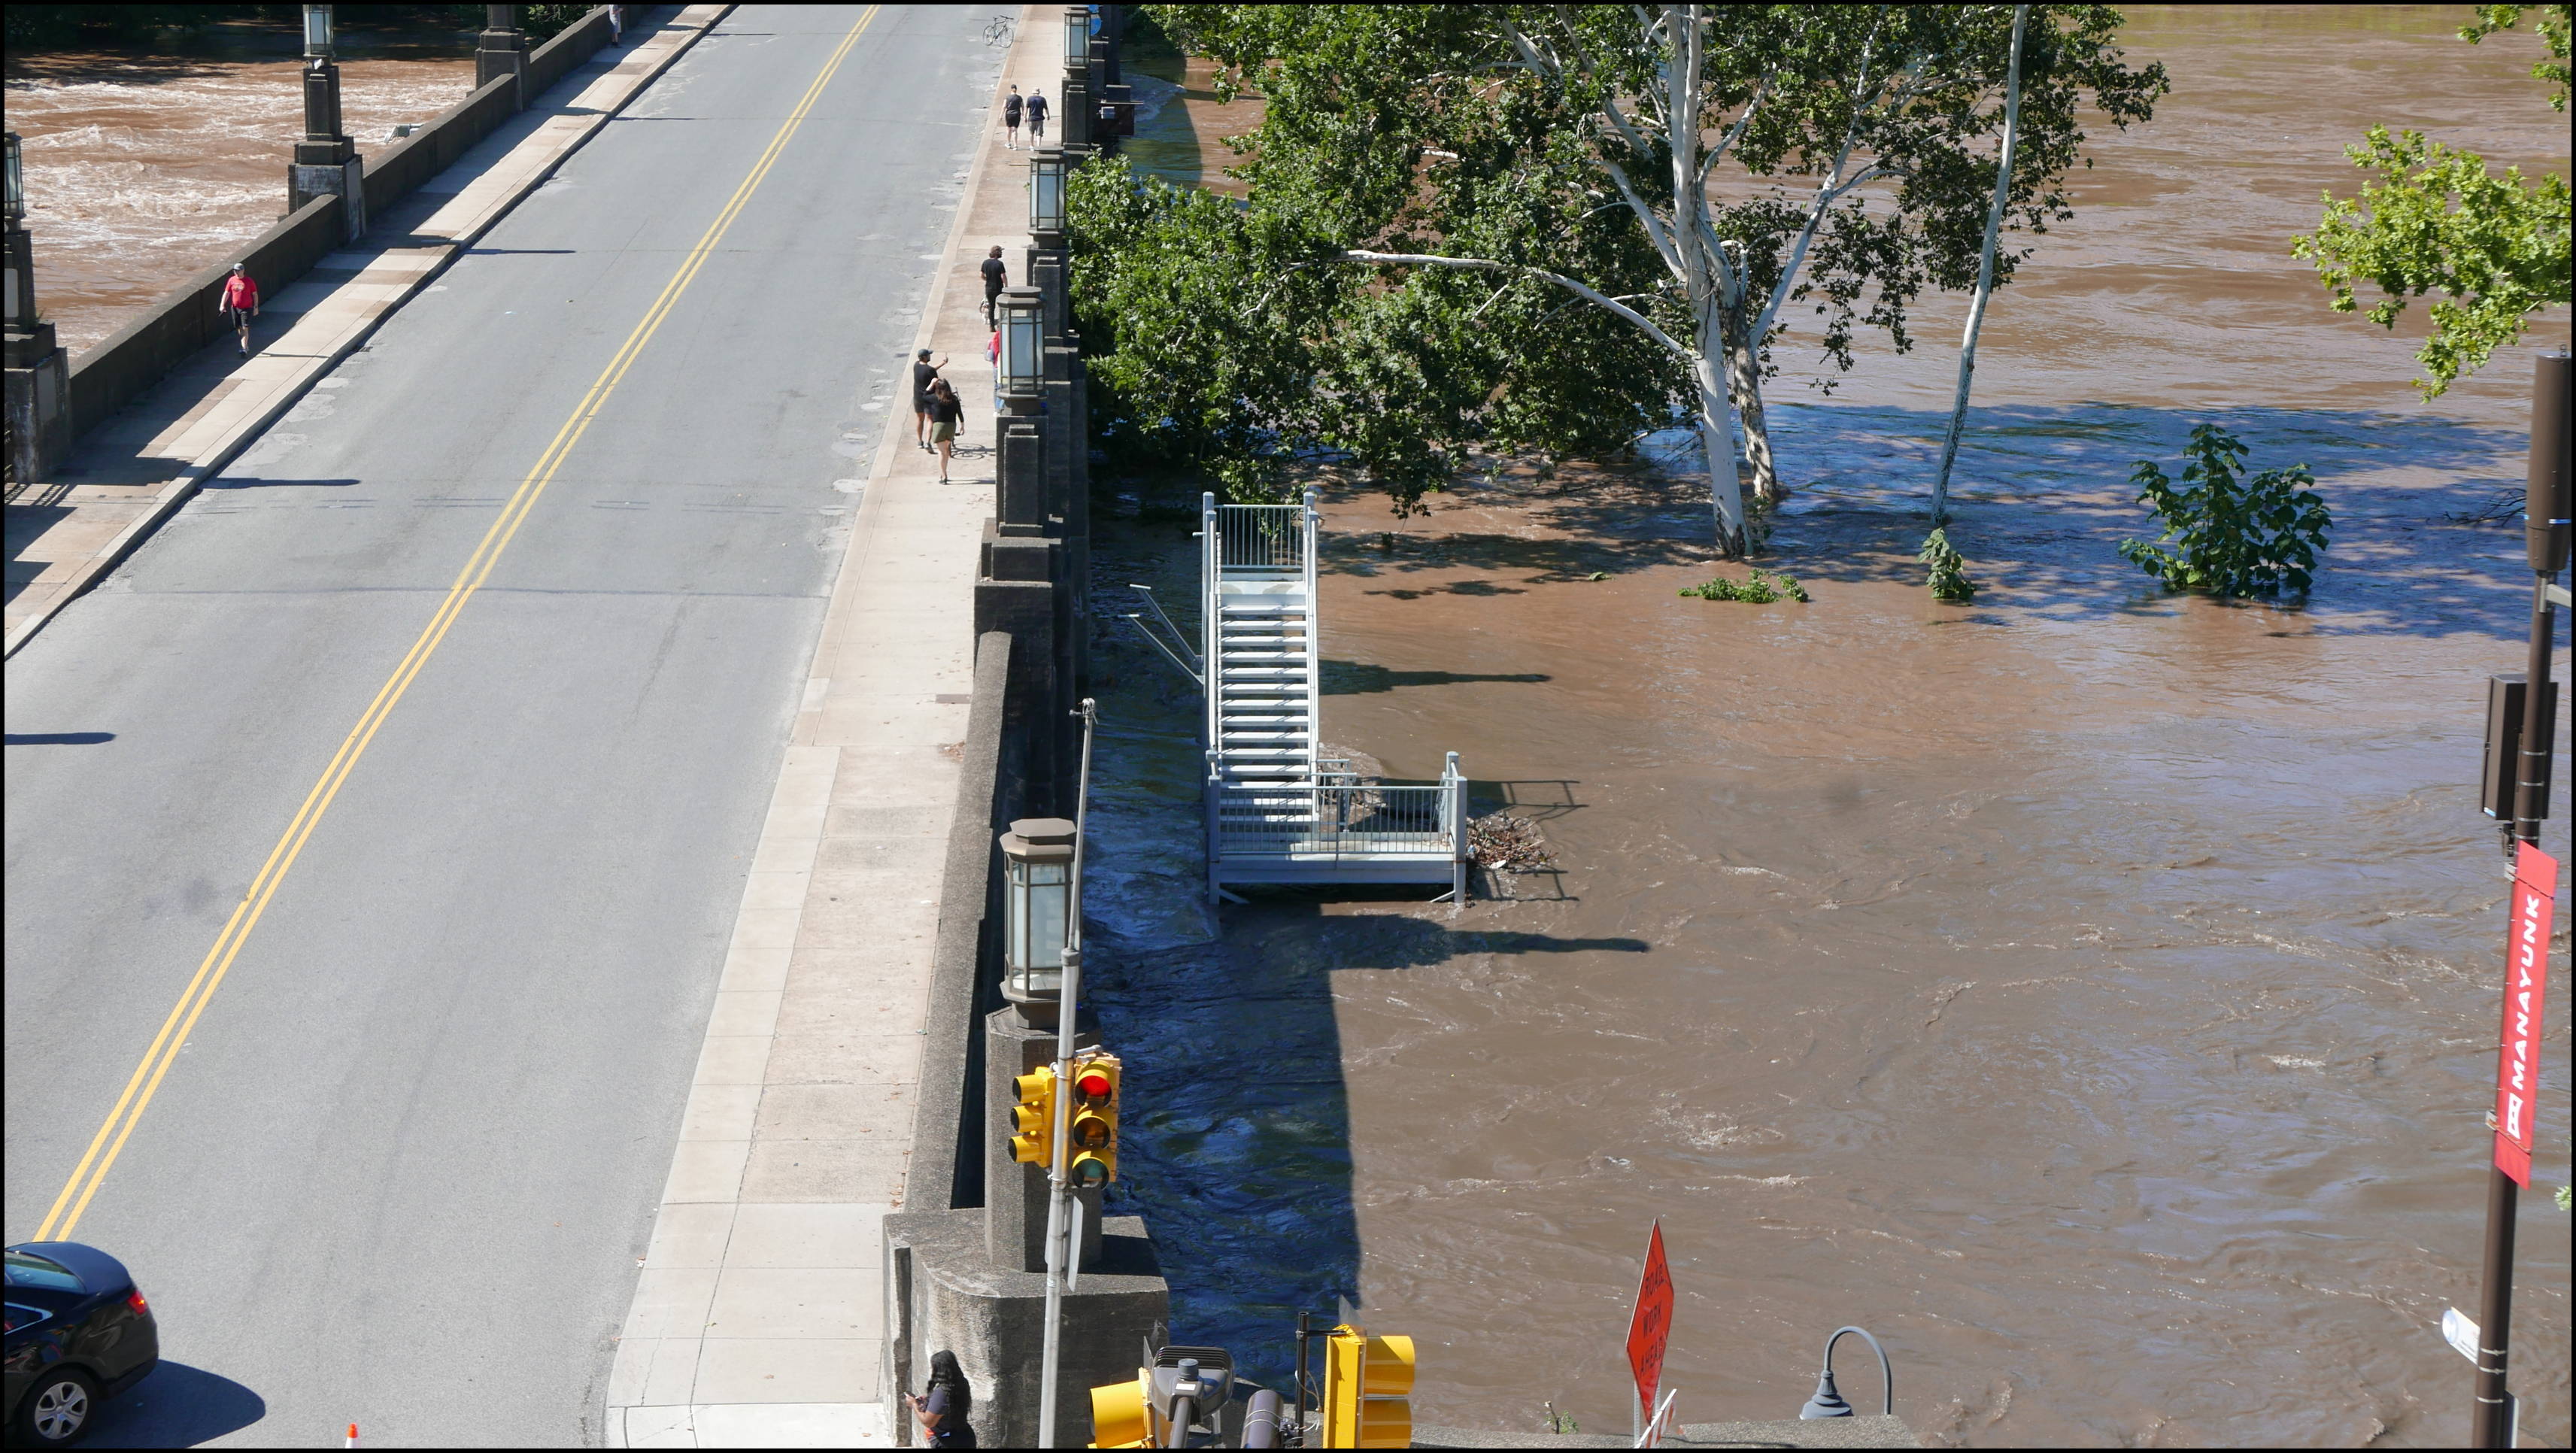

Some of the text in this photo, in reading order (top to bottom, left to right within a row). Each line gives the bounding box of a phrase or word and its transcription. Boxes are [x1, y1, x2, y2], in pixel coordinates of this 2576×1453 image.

[2511, 894, 2540, 1091] MANAYUNK
[1645, 1263, 1665, 1300] ROAD
[1643, 1301, 1661, 1337] WORK
[1640, 1335, 1664, 1376] AHEAD
